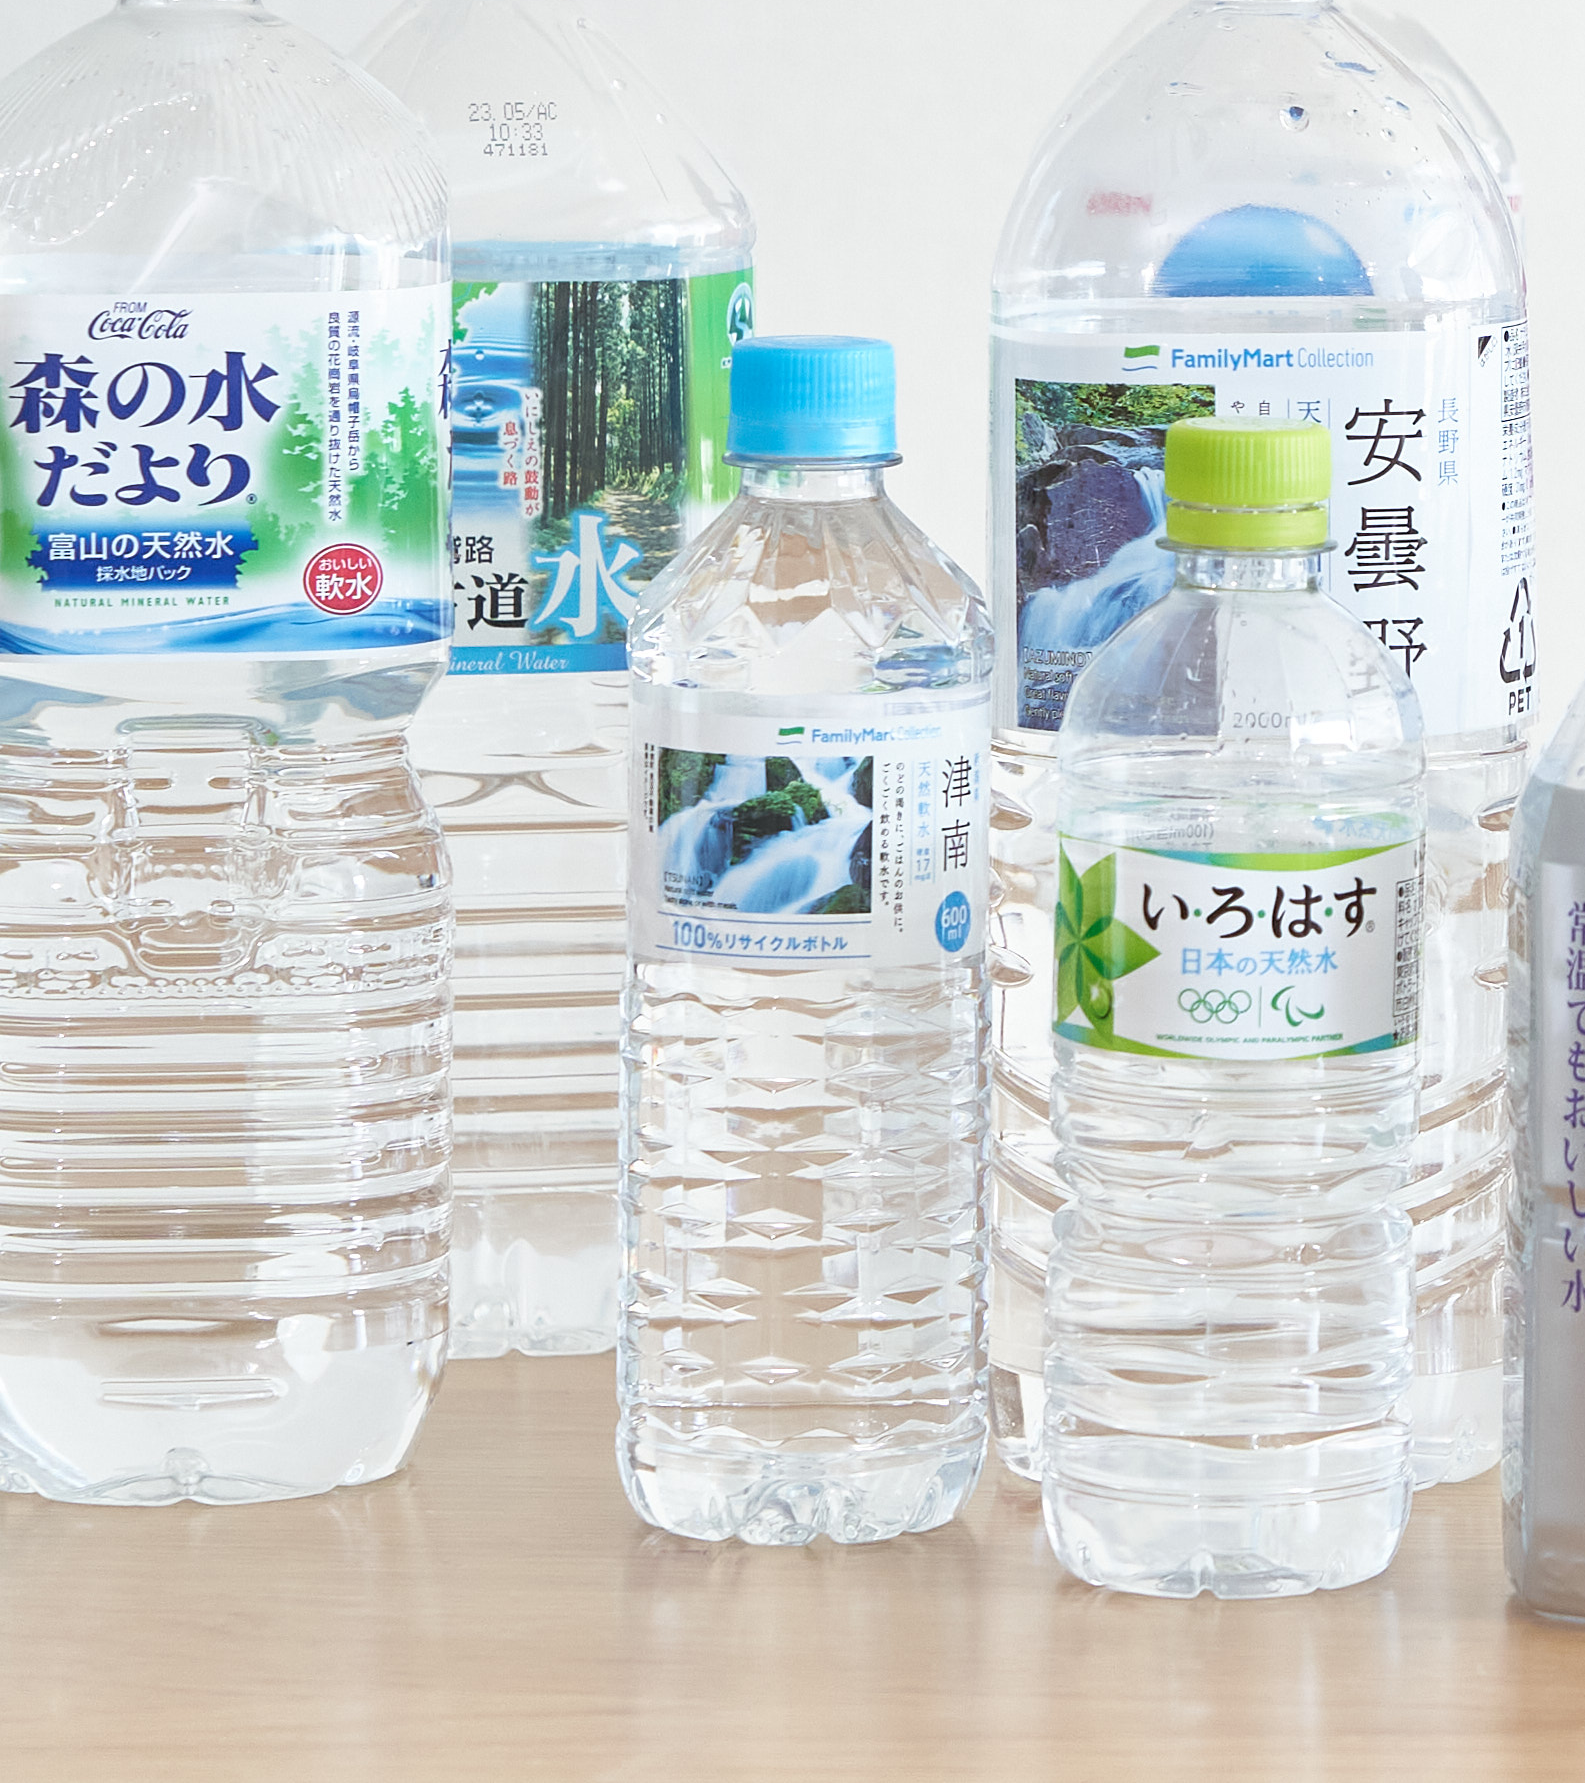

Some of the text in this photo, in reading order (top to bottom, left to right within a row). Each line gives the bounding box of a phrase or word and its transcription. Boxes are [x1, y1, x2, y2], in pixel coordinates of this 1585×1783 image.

[489, 122, 544, 141] 10:33
[483, 143, 548, 156] 471181
[113, 302, 147, 313] FROM
[1171, 347, 1374, 371] FamilyMart Collection
[9, 351, 281, 434] 森の水
[502, 422, 519, 487] 息づく路
[524, 391, 541, 515] いにしえの鼓動が
[1438, 397, 1460, 487] 長野県
[33, 441, 251, 507] だより
[48, 532, 235, 560] 富山の天然水
[318, 557, 373, 572] おいしい
[315, 573, 373, 601] 軟水
[54, 596, 230, 608] NATURAL MINERAL WATER
[449, 650, 570, 672] ineral Water
[1508, 686, 1532, 716] PET
[811, 728, 896, 744] FamilyMart
[941, 755, 972, 873] 津南
[941, 905, 968, 927] 600
[671, 919, 849, 952] 100%リサイクルボトル
[1181, 945, 1340, 977] 日本の天然水
